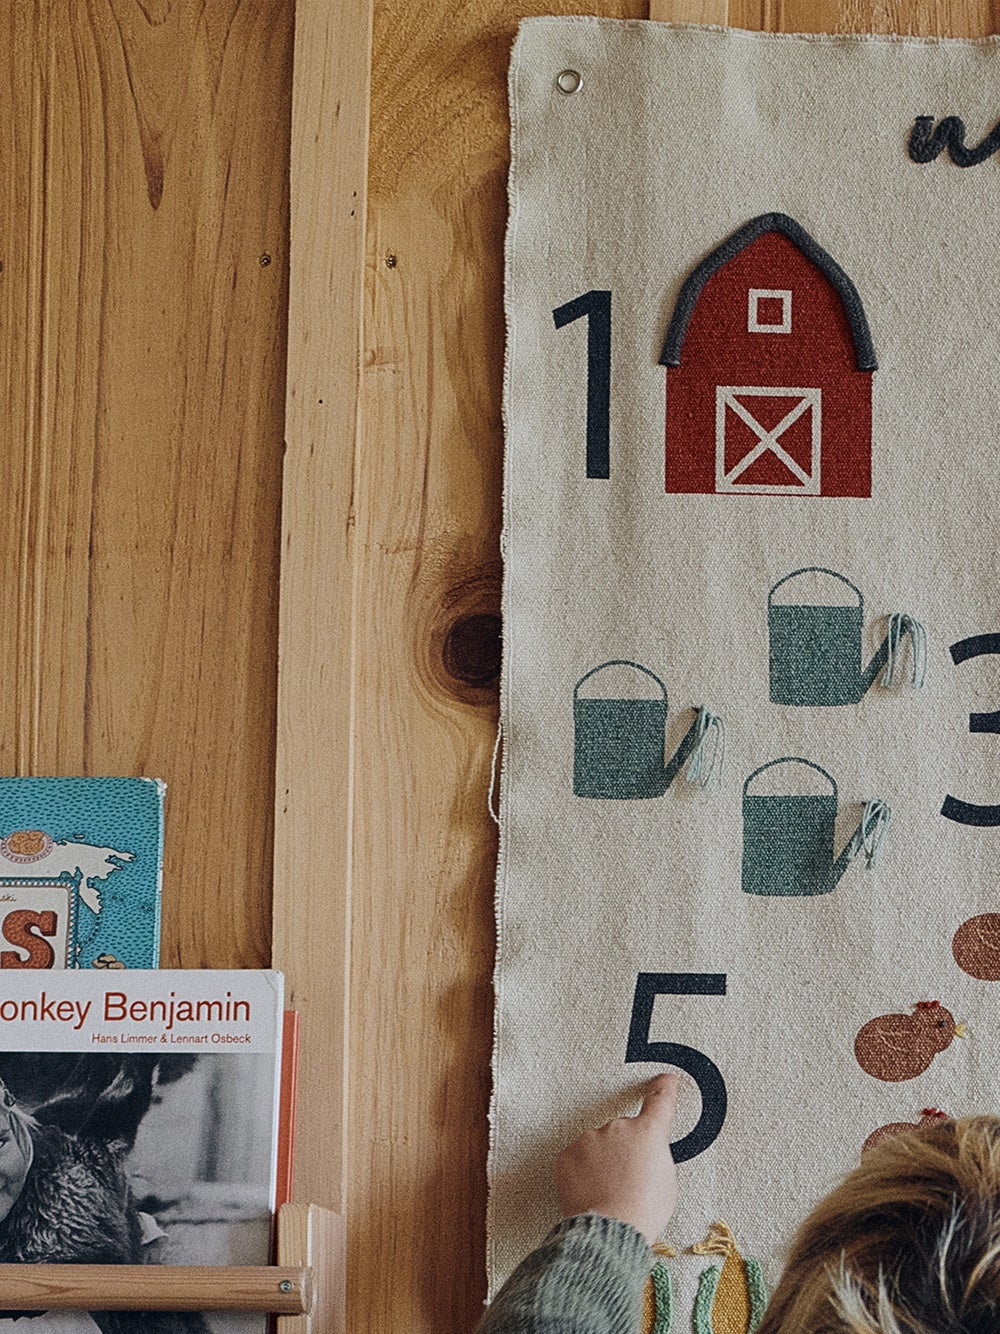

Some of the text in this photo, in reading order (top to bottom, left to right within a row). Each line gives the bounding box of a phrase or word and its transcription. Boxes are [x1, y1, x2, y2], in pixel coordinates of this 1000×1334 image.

[552, 289, 613, 480] 1
[0, 991, 250, 1030] onkey Benjamin
[91, 1033, 251, 1044] Hans Limmer & Lennart Osbeck
[624, 972, 728, 1164] 5
